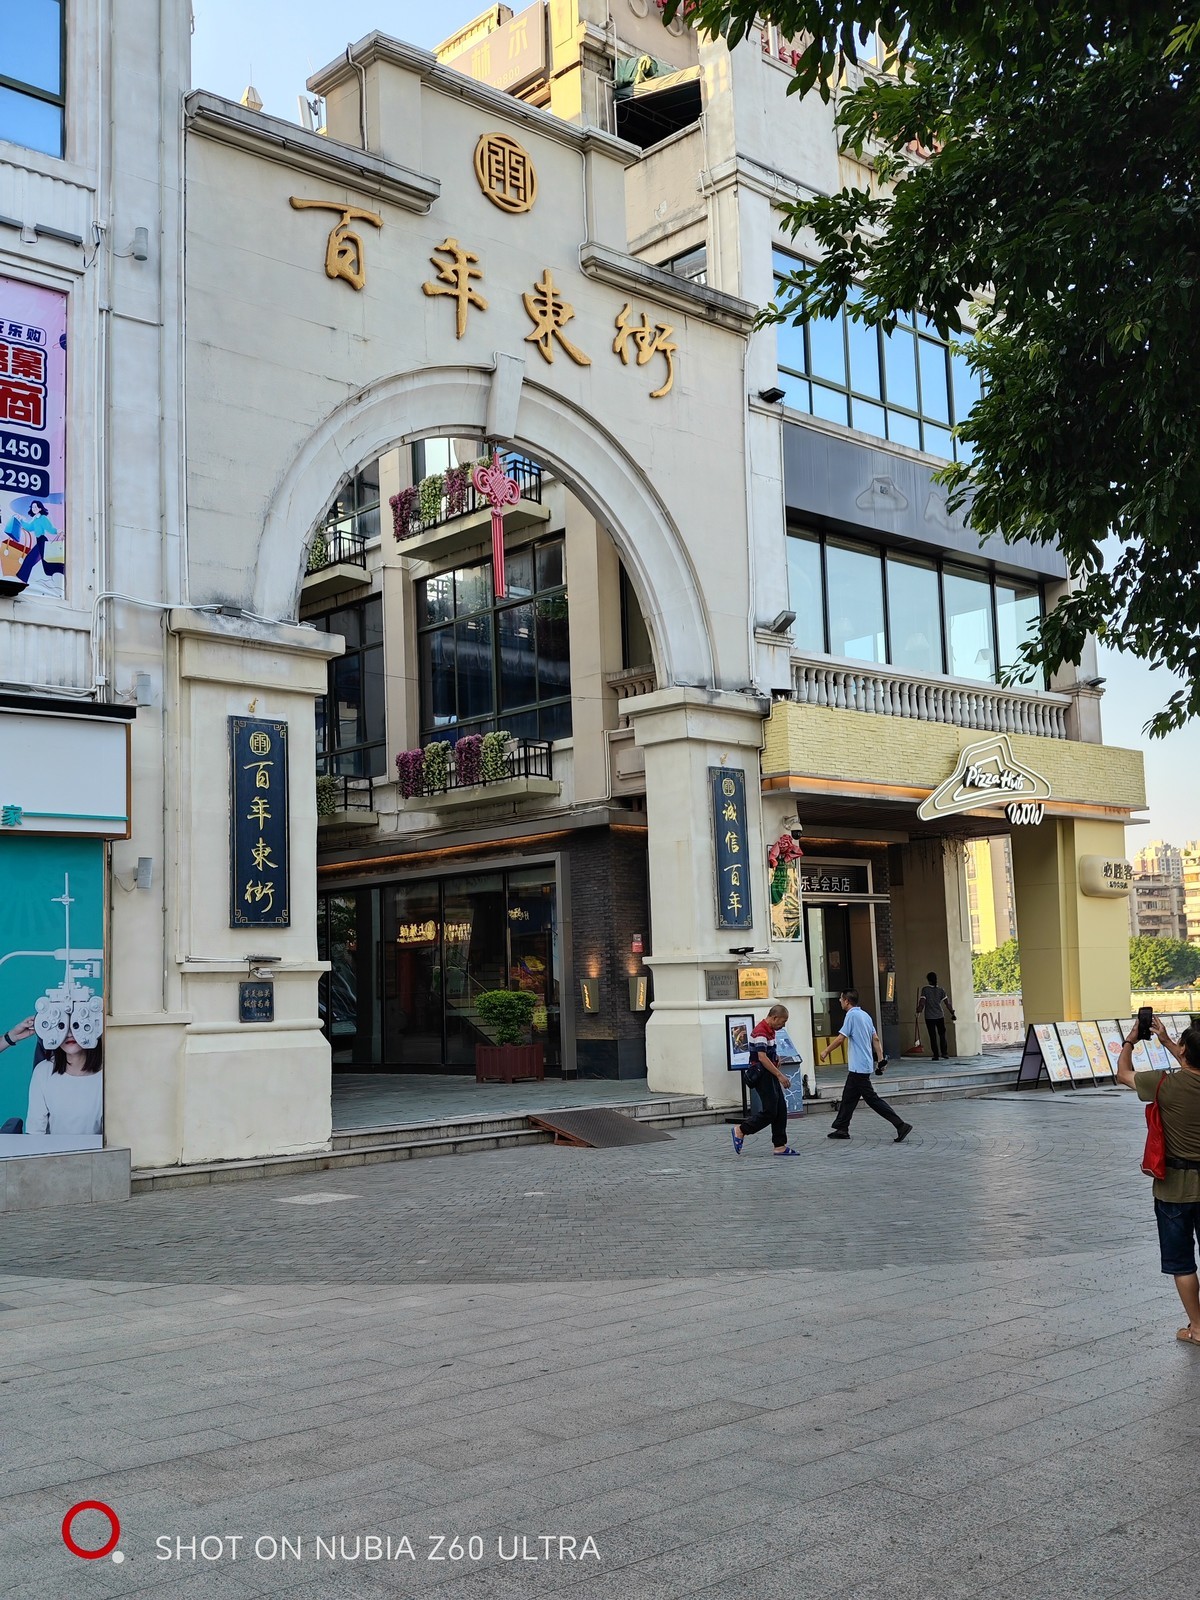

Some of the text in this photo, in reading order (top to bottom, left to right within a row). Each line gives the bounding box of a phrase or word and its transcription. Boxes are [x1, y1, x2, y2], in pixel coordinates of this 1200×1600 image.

[966, 765, 1026, 790] Pizza Hut
[1103, 861, 1133, 880] 必胜客
[800, 875, 850, 892] 乐享会员店
